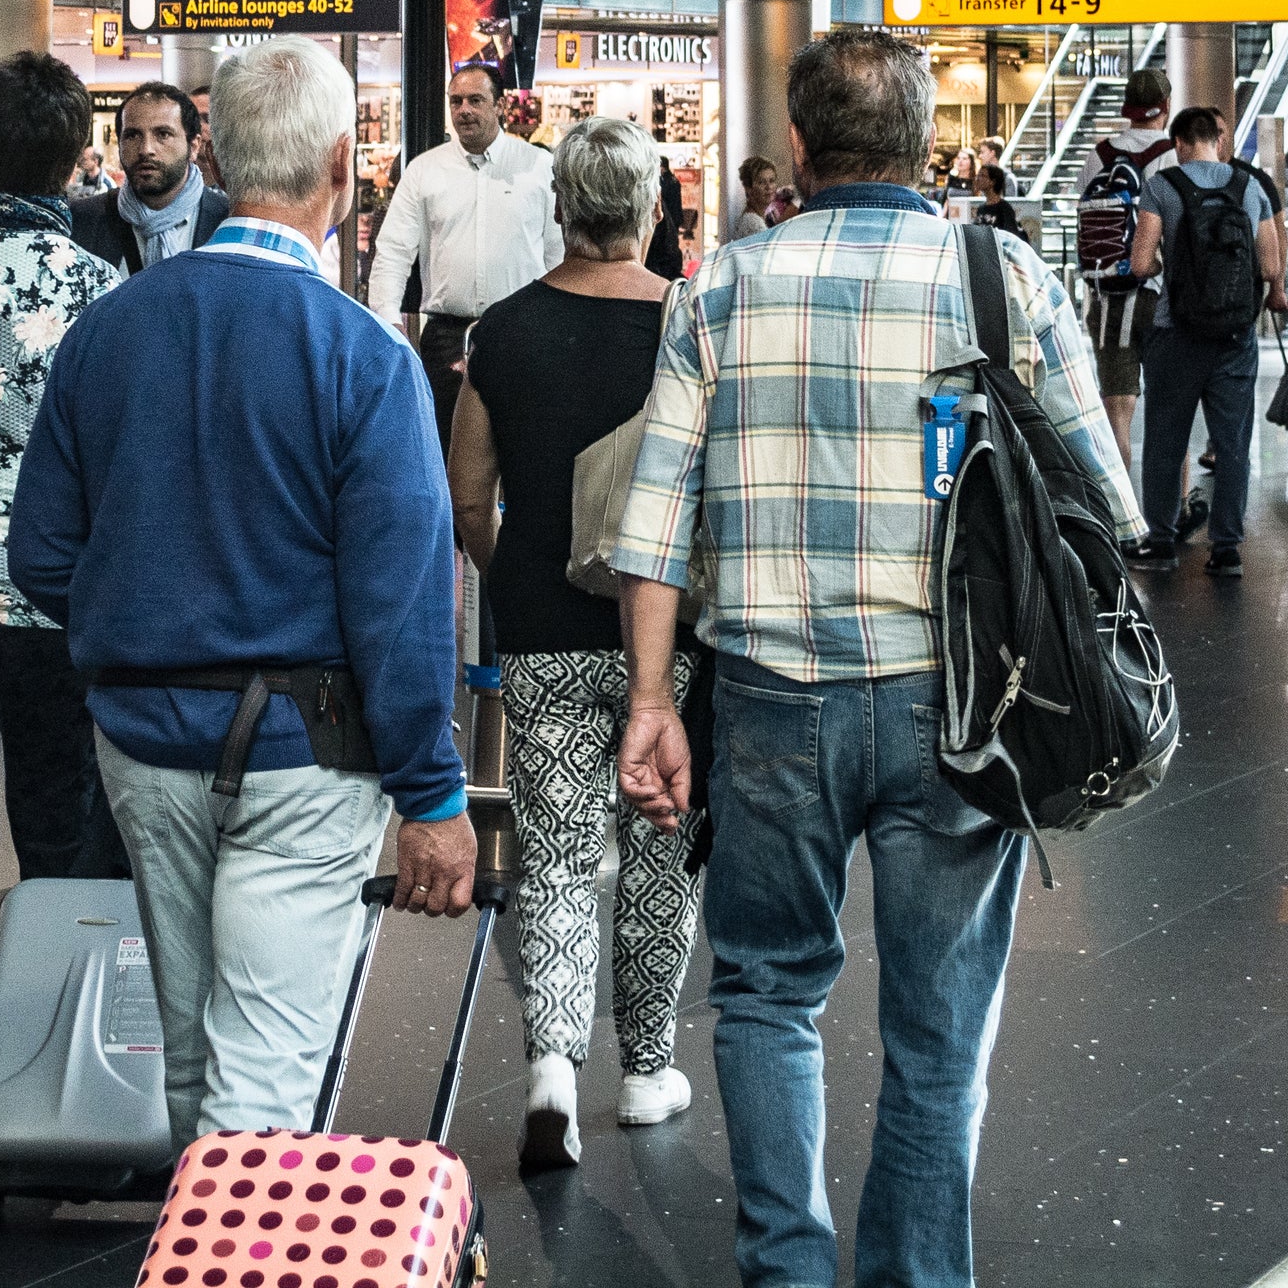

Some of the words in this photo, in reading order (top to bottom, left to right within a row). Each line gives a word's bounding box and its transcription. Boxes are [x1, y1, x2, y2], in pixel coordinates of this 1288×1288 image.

[186, 0, 238, 15] Airline
[242, 0, 305, 18] lounges
[186, 17, 197, 29] By
[200, 15, 248, 27] invitation
[251, 17, 275, 29] only
[598, 34, 712, 64] ELECTRONICS
